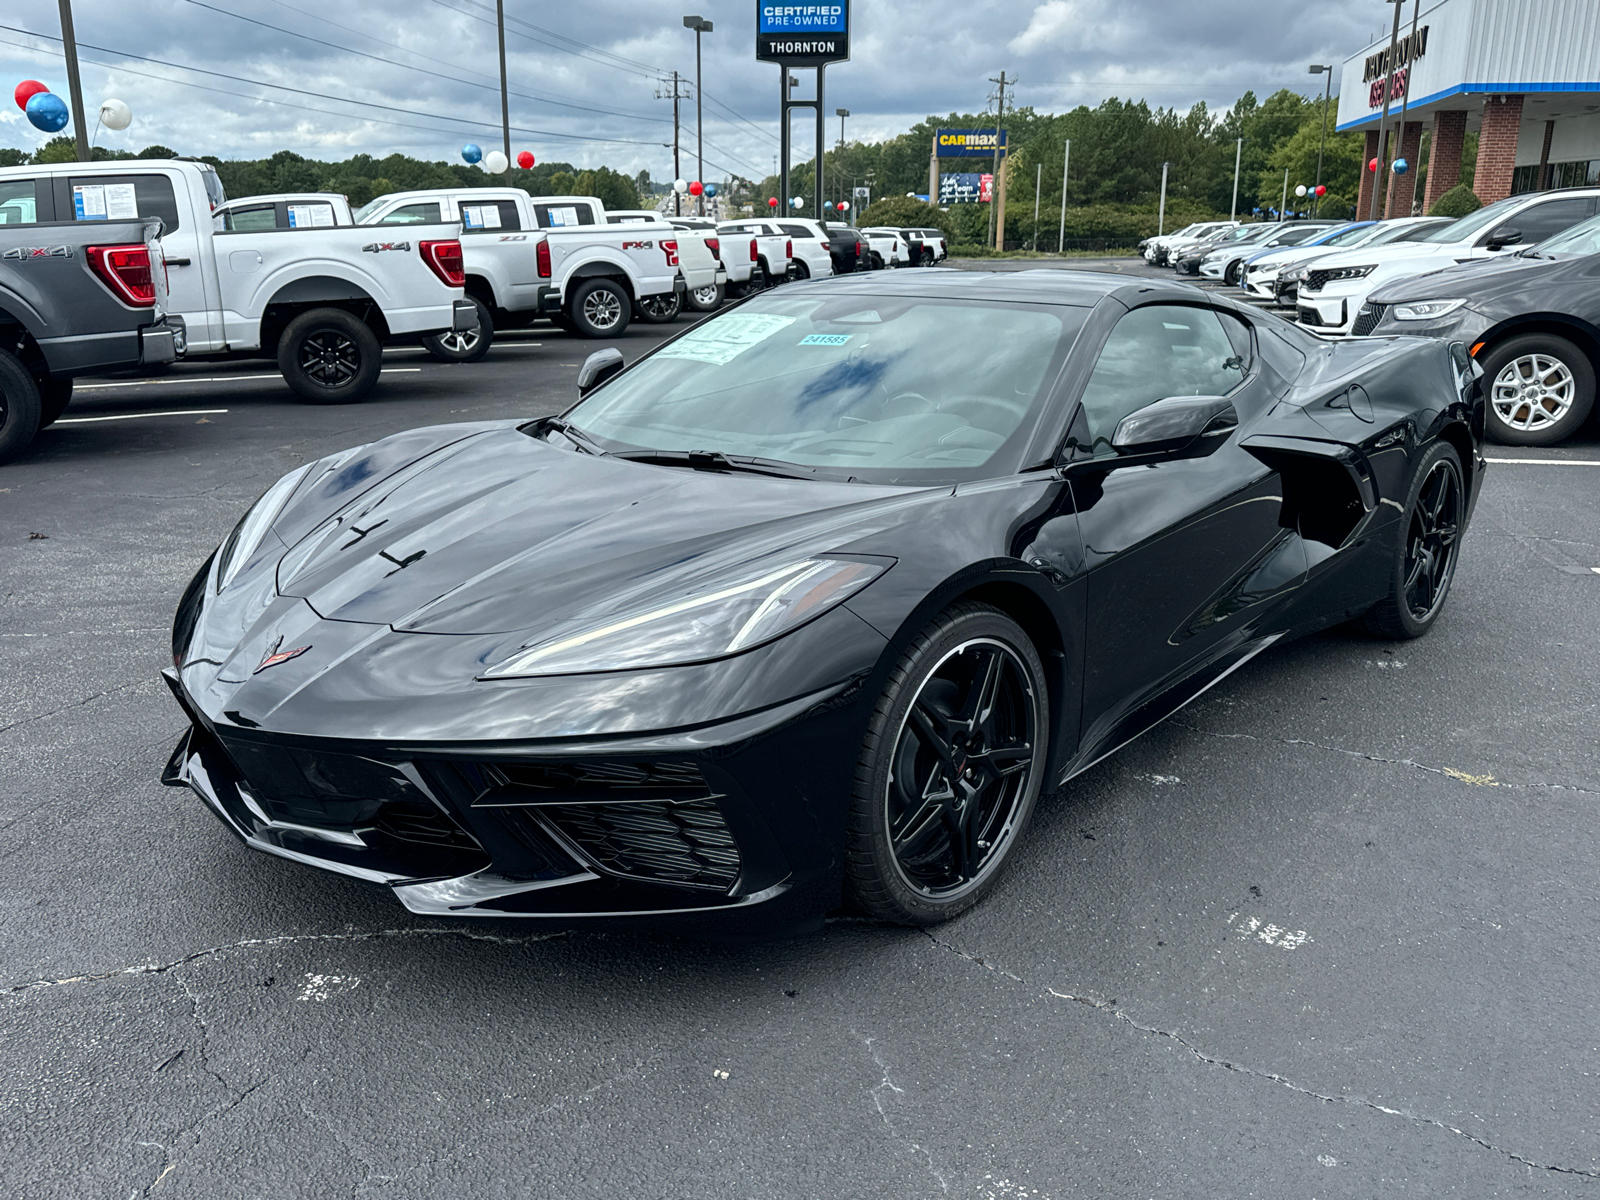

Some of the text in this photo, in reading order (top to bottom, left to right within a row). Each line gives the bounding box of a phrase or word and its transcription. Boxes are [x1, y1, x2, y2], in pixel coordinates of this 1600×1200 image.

[764, 6, 841, 16] CERTIFIED
[767, 16, 838, 26] PRE-OWNED
[769, 41, 835, 53] THORNTON
[1388, 69, 1407, 101] ARS
[622, 241, 653, 250] FX4
[804, 335, 848, 344] 241585
